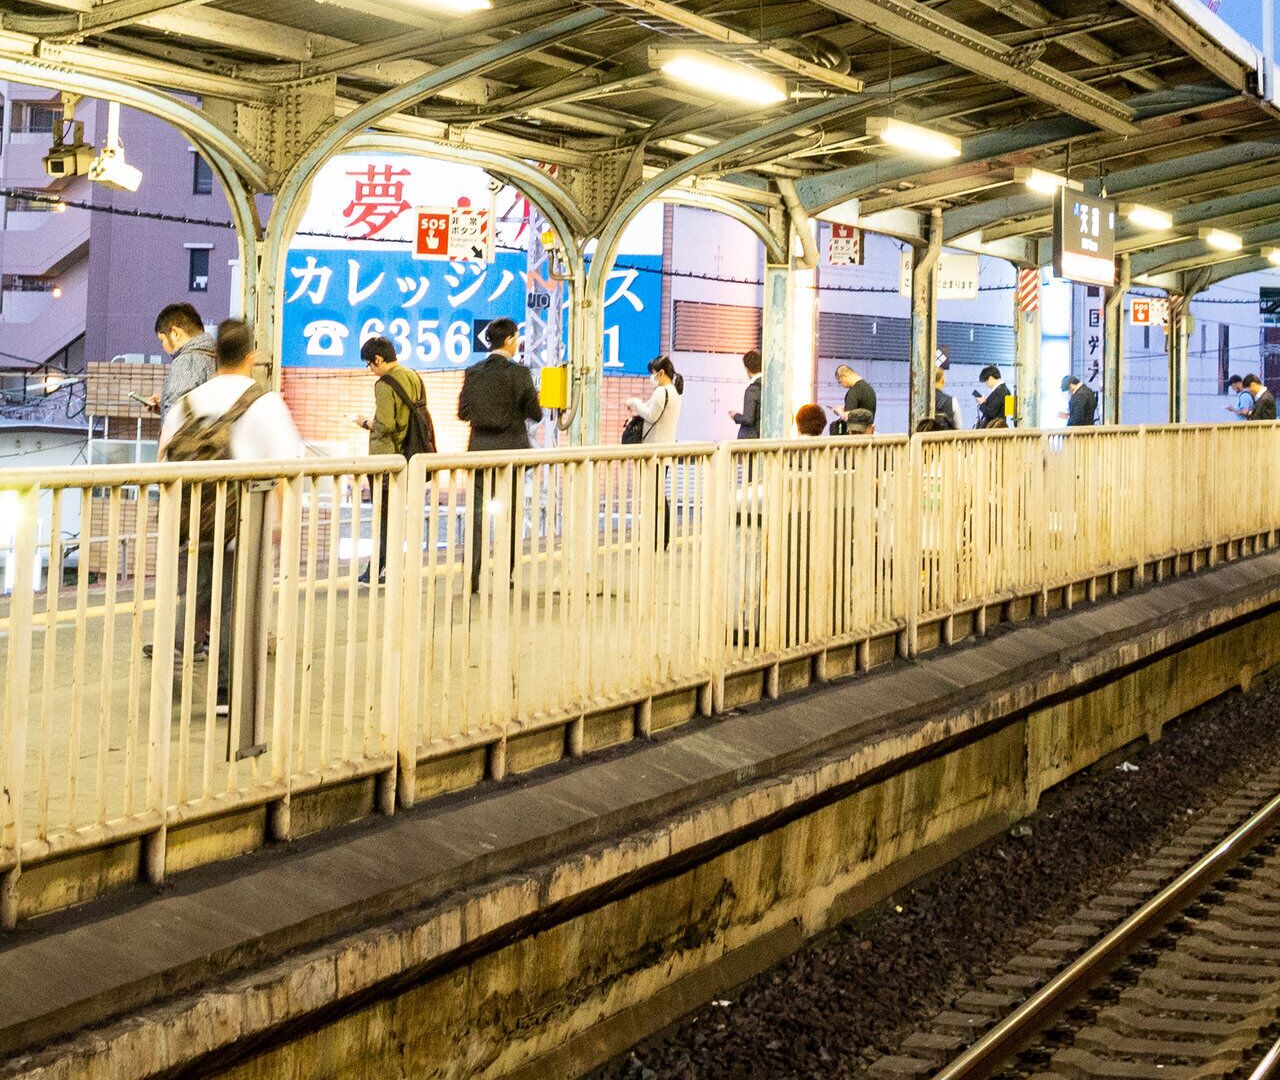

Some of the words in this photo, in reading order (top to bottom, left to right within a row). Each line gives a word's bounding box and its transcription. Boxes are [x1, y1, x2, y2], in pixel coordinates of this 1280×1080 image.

[343, 164, 413, 241] 夢
[421, 218, 446, 230] SOS
[451, 226, 478, 235] ボタン
[287, 254, 645, 314] カレッジハス
